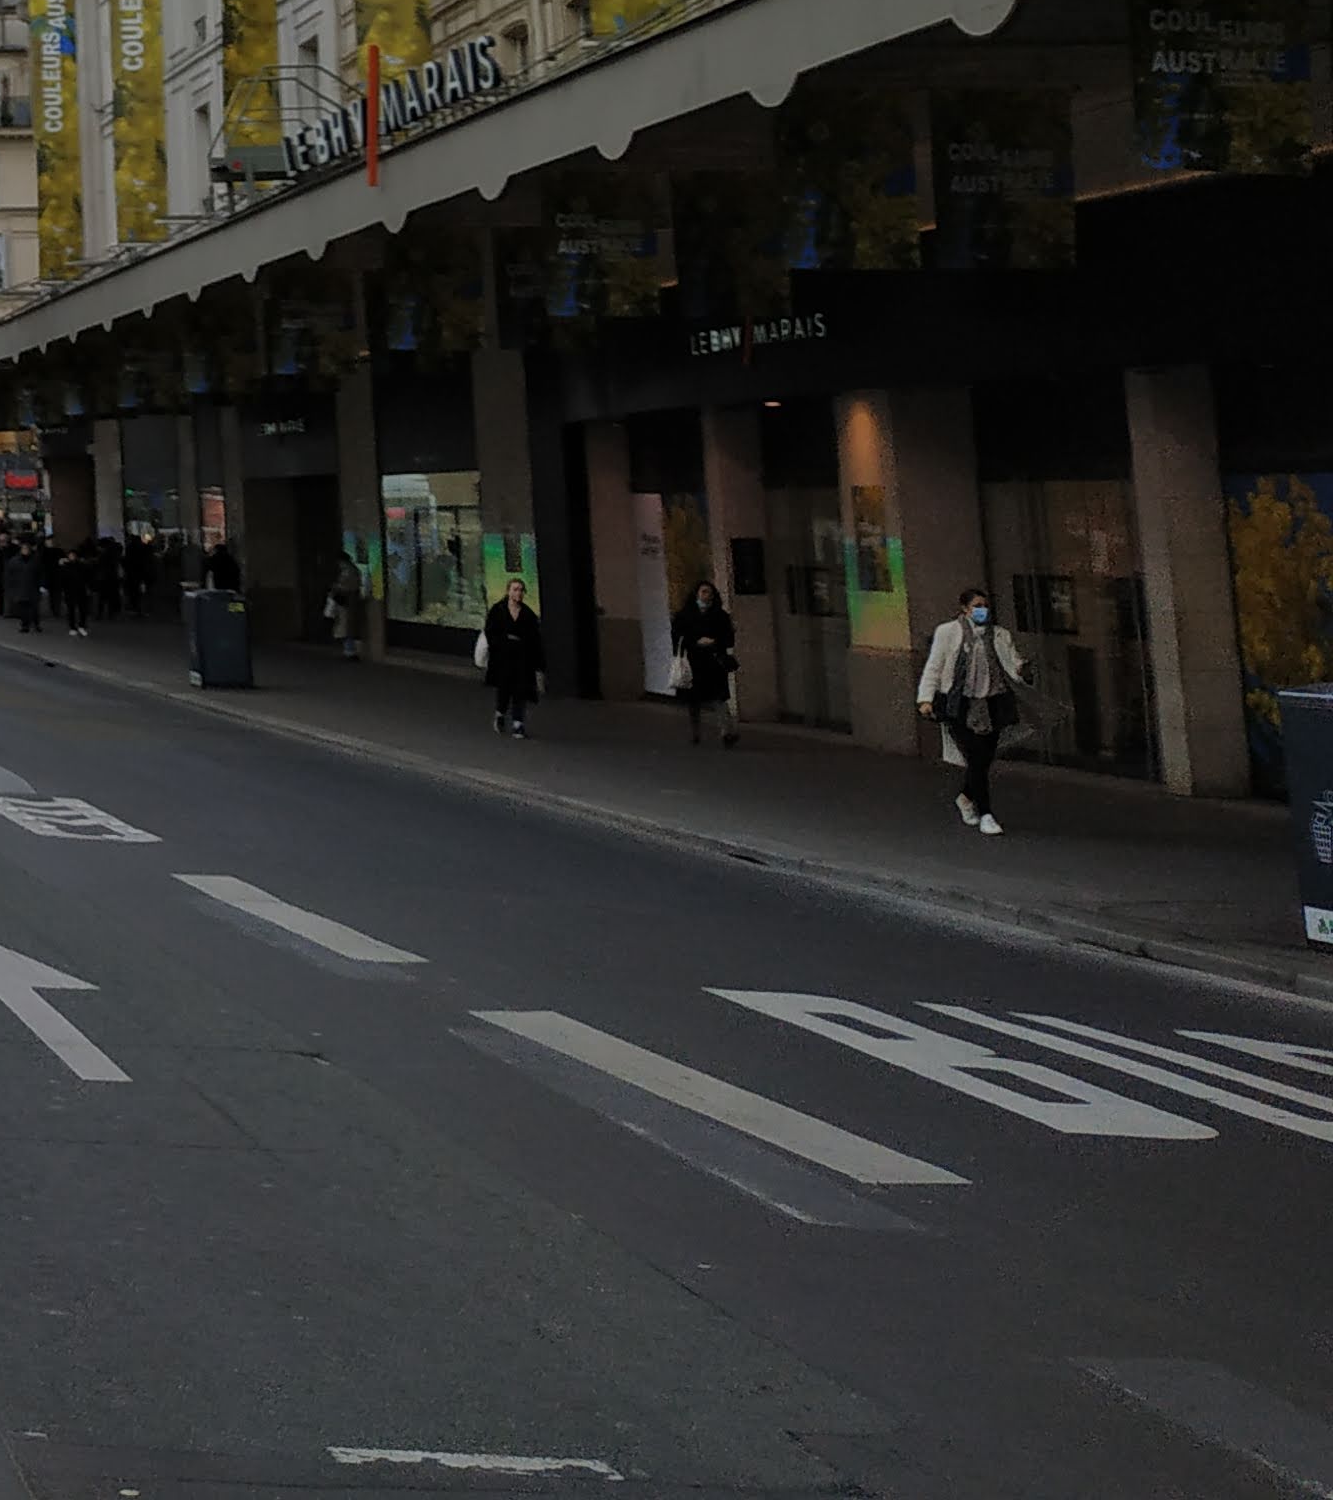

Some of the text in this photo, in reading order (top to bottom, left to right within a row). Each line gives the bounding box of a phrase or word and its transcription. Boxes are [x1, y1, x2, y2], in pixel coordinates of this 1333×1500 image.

[42, 32, 63, 133] COULEURS
[380, 35, 501, 136] MARAIS
[701, 986, 1333, 1143] BU
